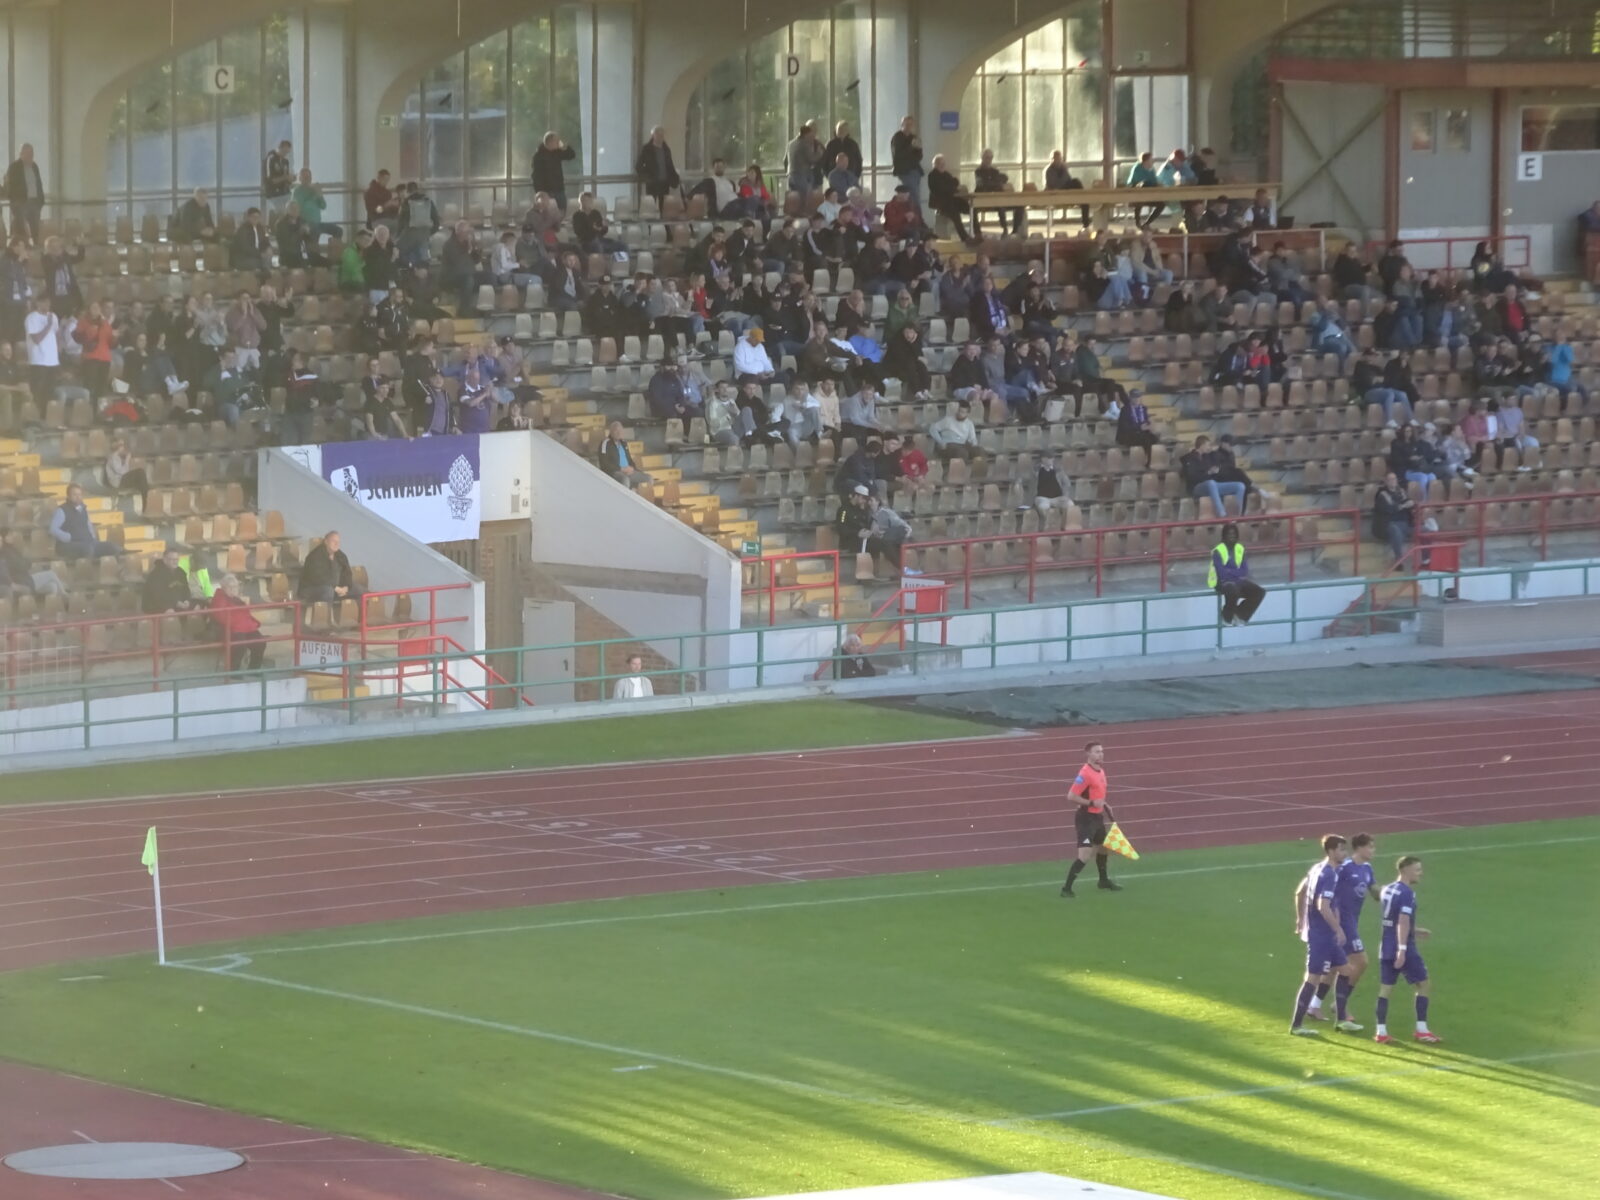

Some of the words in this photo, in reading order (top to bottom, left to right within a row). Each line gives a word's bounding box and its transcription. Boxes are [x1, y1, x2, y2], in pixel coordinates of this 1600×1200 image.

[787, 56, 799, 76] D
[215, 68, 228, 90] C
[1525, 158, 1536, 177] E
[301, 641, 344, 657] AUFGAN
